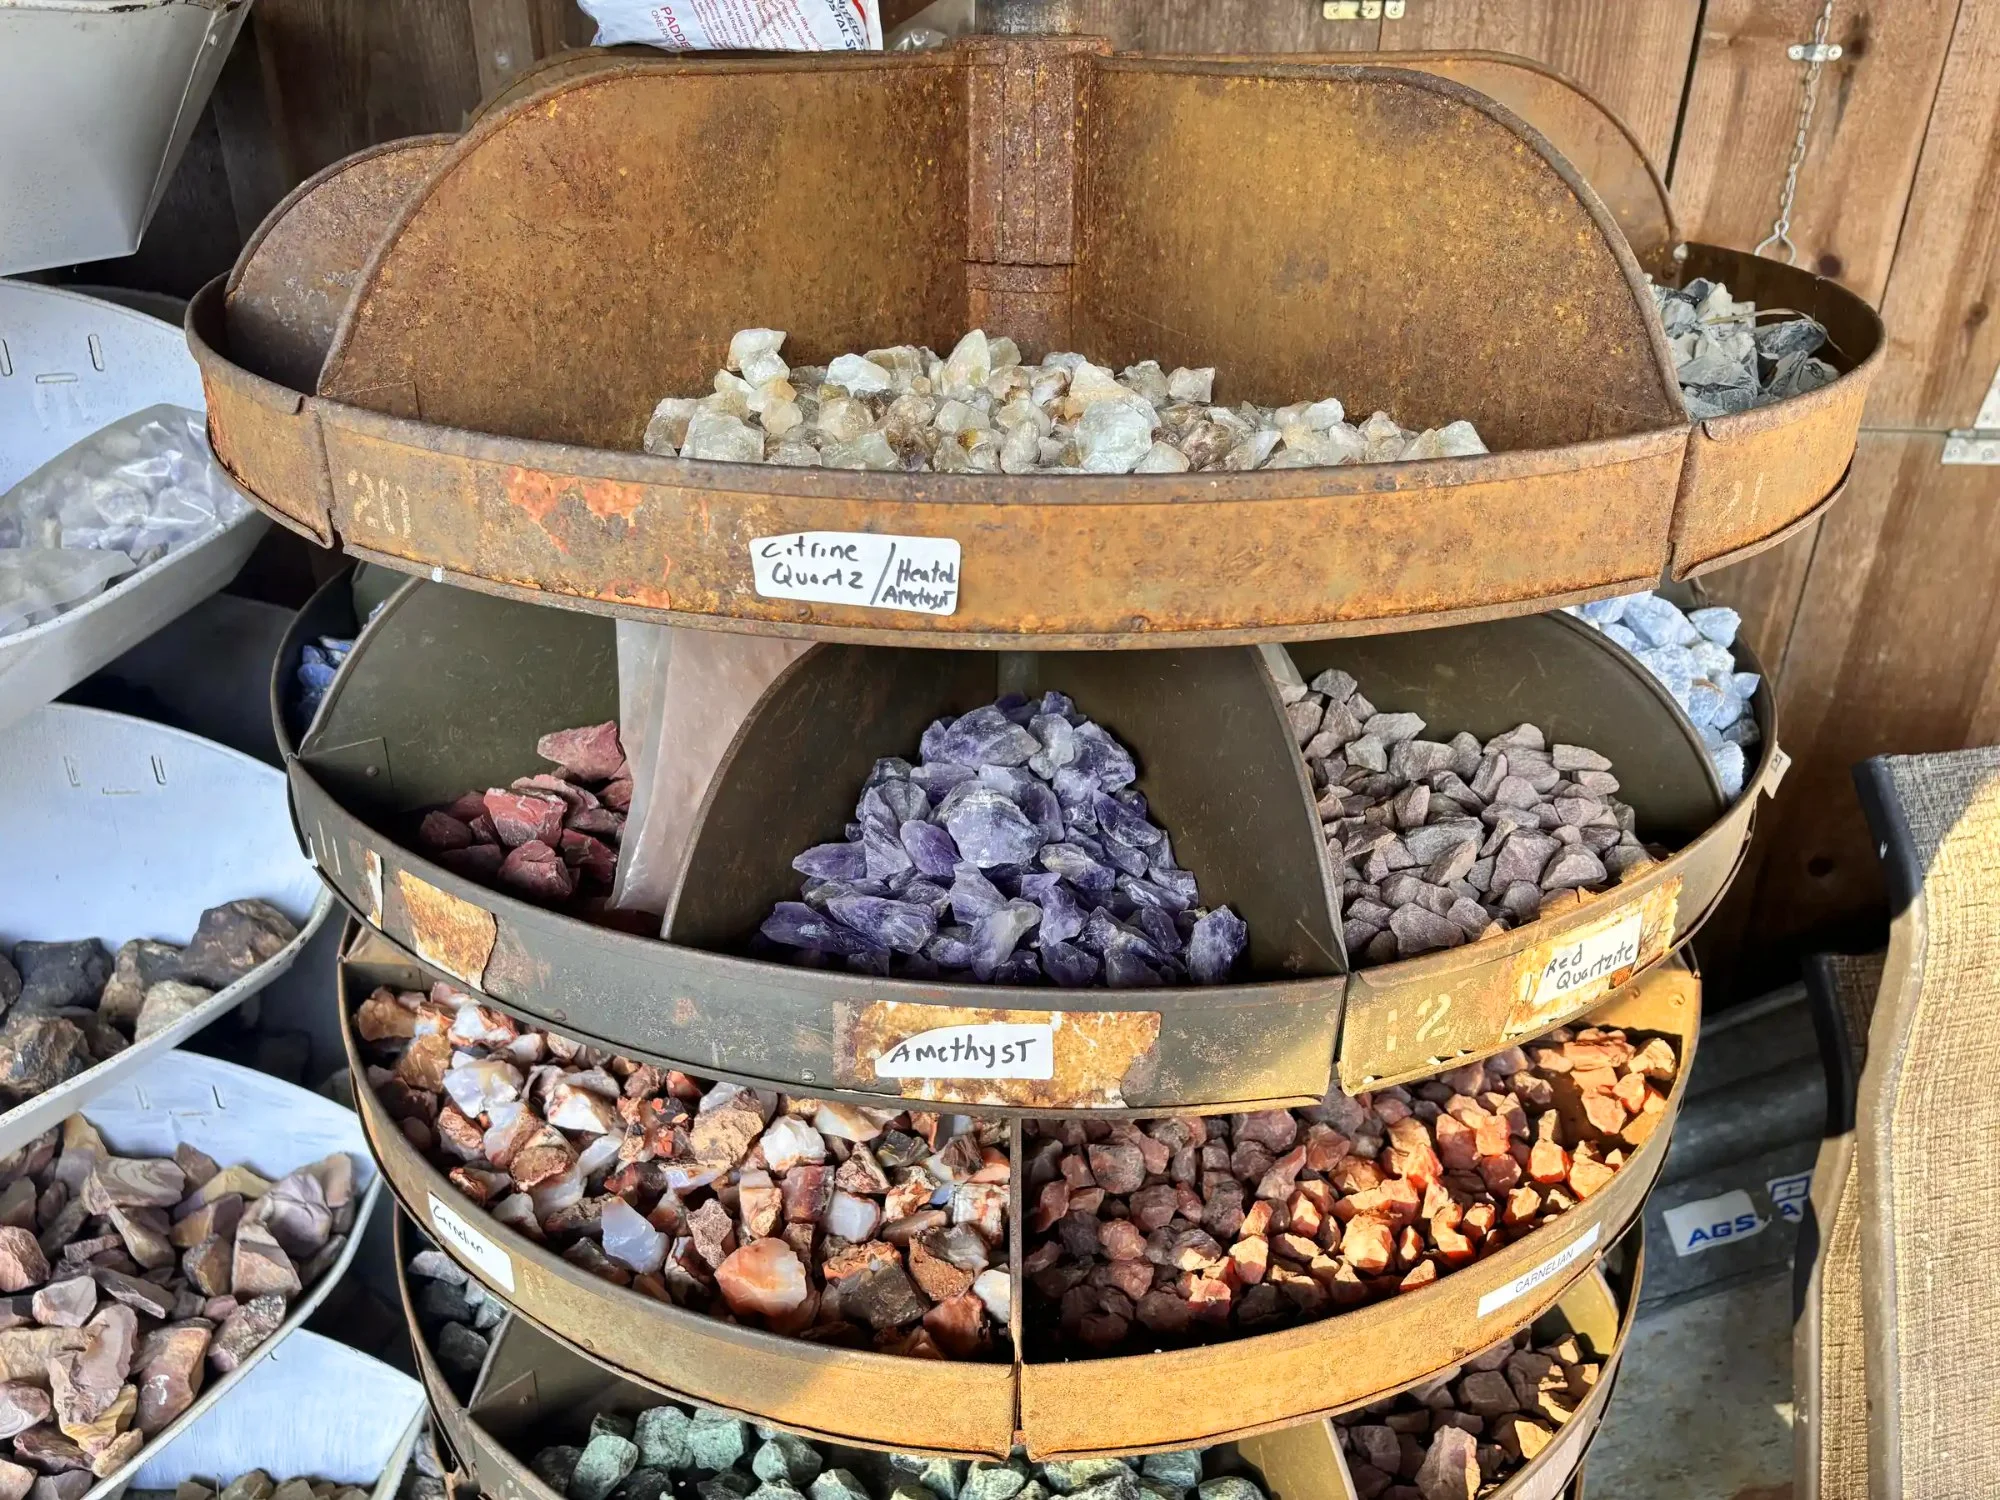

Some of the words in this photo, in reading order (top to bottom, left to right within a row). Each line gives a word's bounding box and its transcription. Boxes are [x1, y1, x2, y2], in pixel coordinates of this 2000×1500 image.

[651, 9, 664, 28] ONE
[660, 6, 693, 48] PADDE
[1545, 942, 1583, 979] Red
[1556, 941, 1635, 990] Quartzite
[1687, 1213, 1757, 1248] AGS
[1514, 1248, 1575, 1294] CARNELIAN
